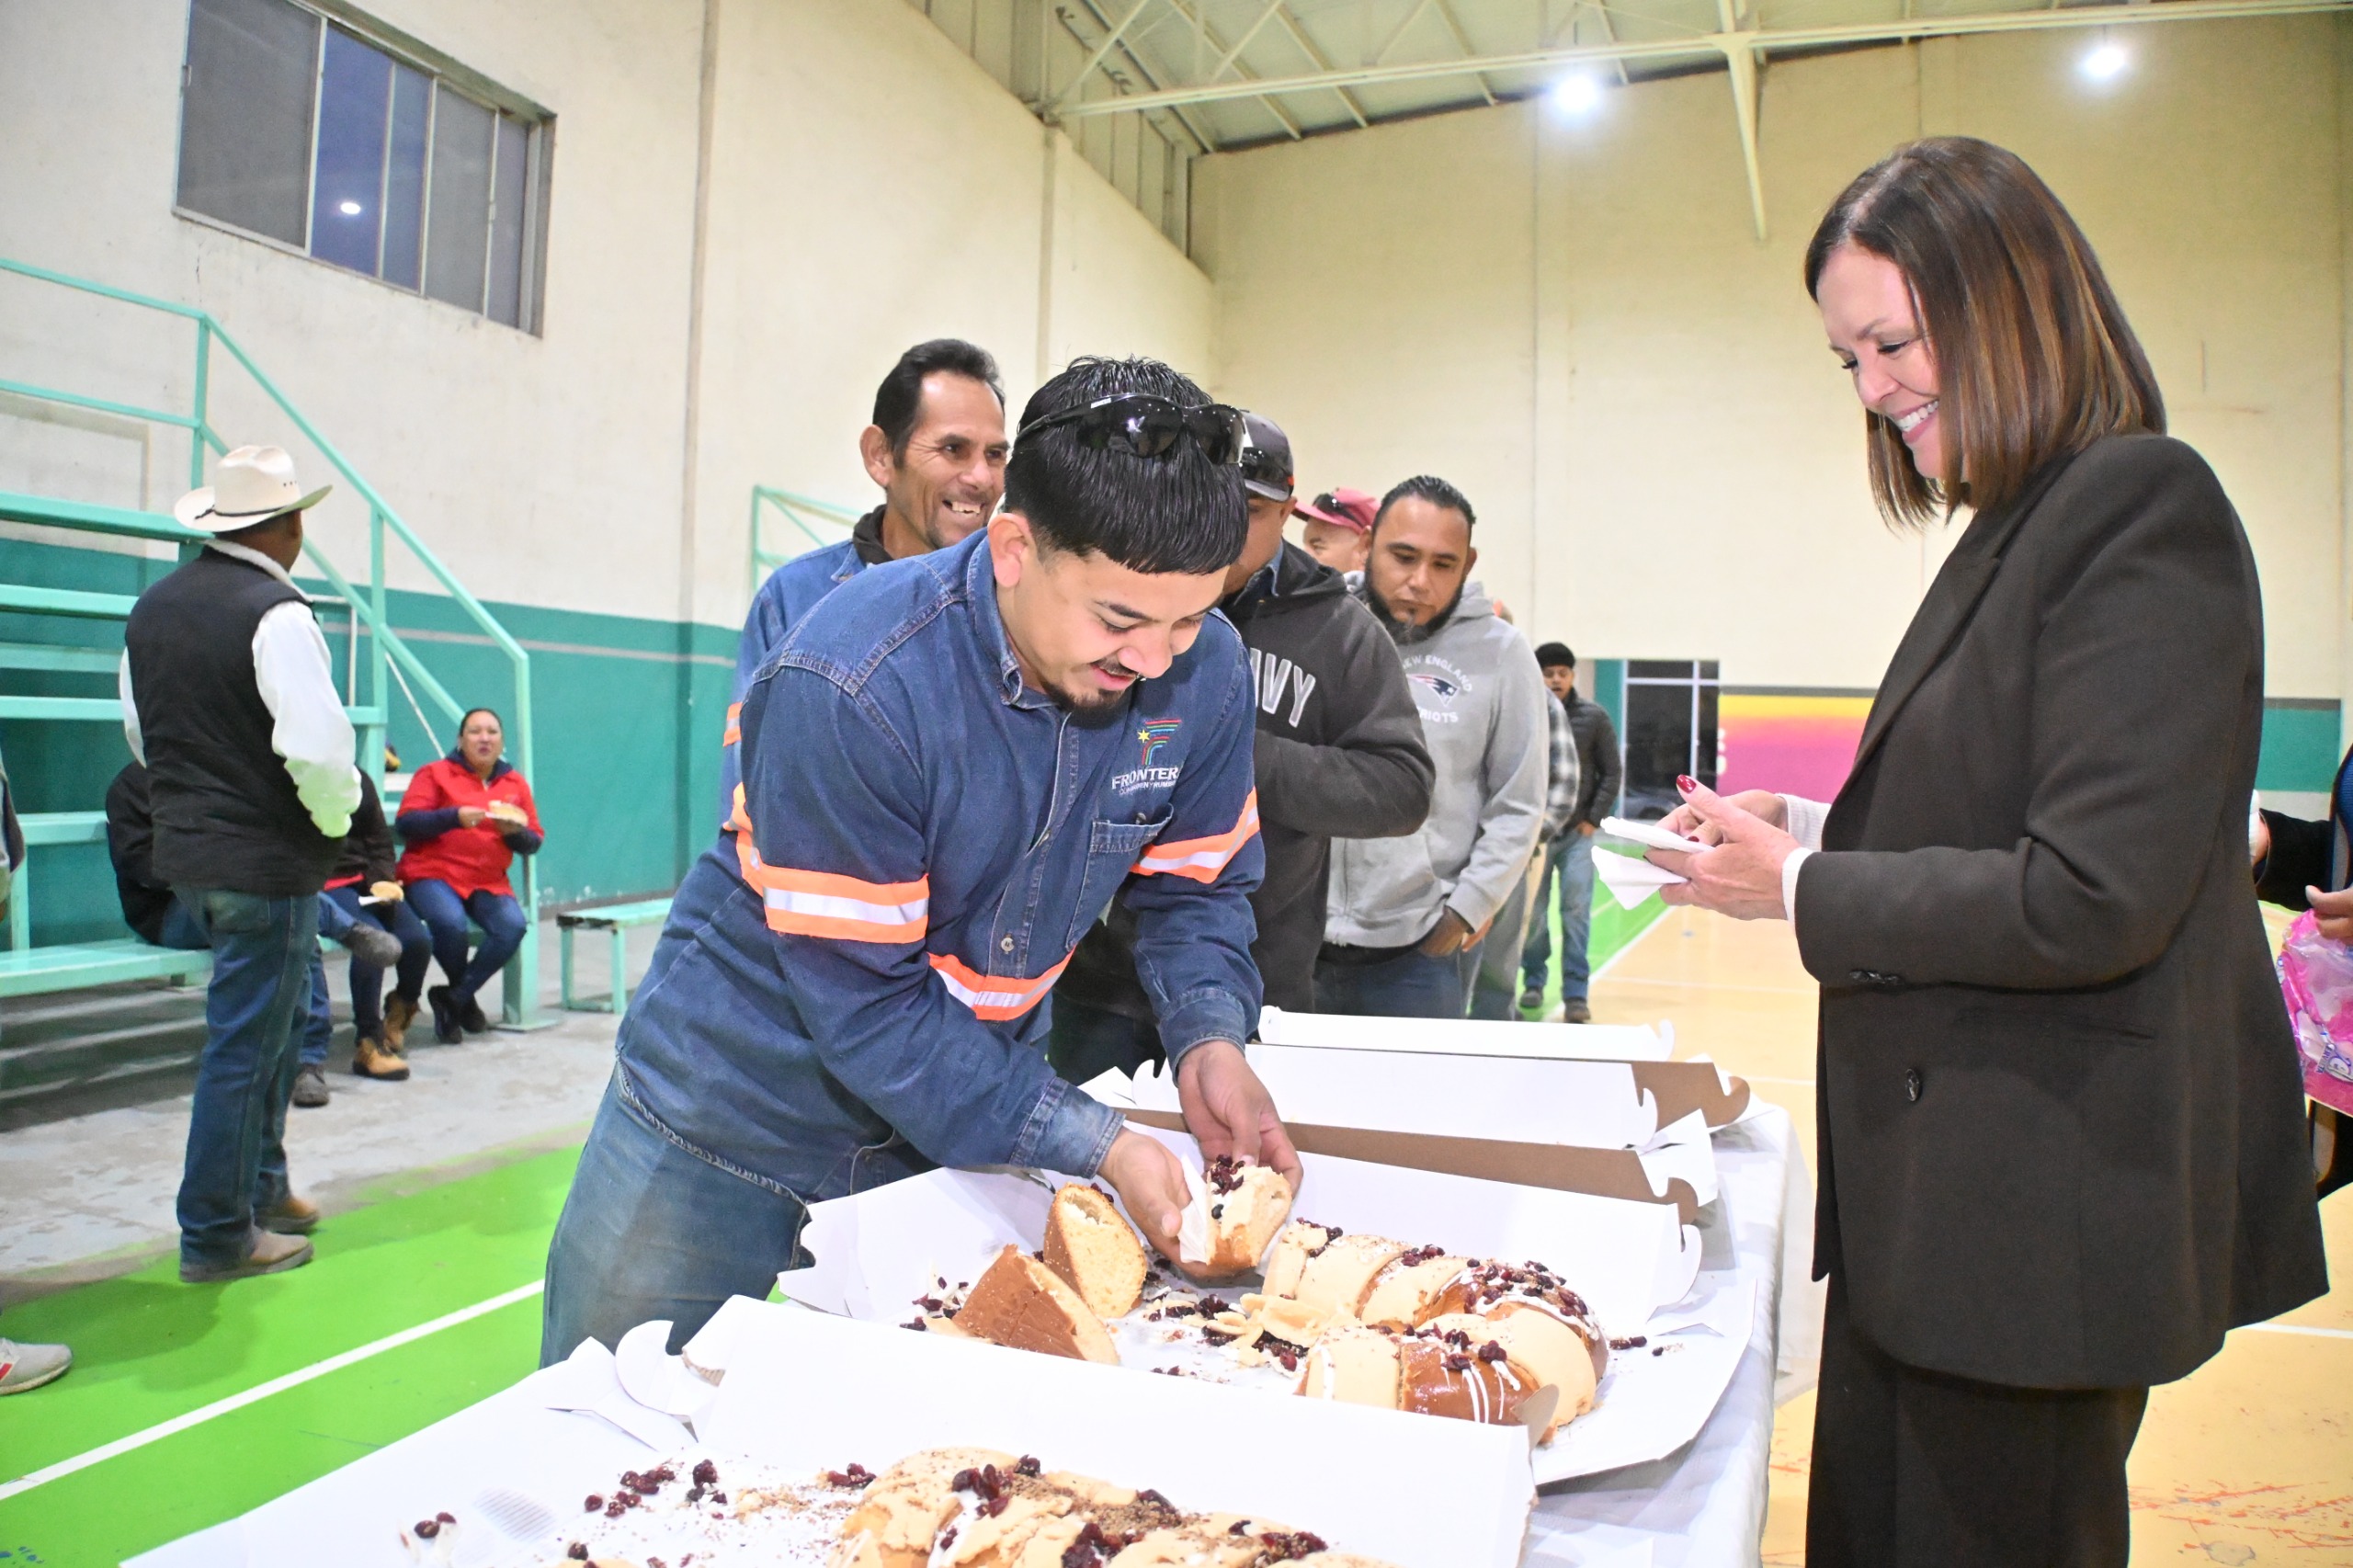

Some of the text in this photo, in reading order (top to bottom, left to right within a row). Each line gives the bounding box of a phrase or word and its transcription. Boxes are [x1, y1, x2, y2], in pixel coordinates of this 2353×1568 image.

[1425, 654, 1472, 693] ENGLAND
[1416, 705, 1459, 723] RIOTS
[1111, 767, 1180, 790] FRONTER
